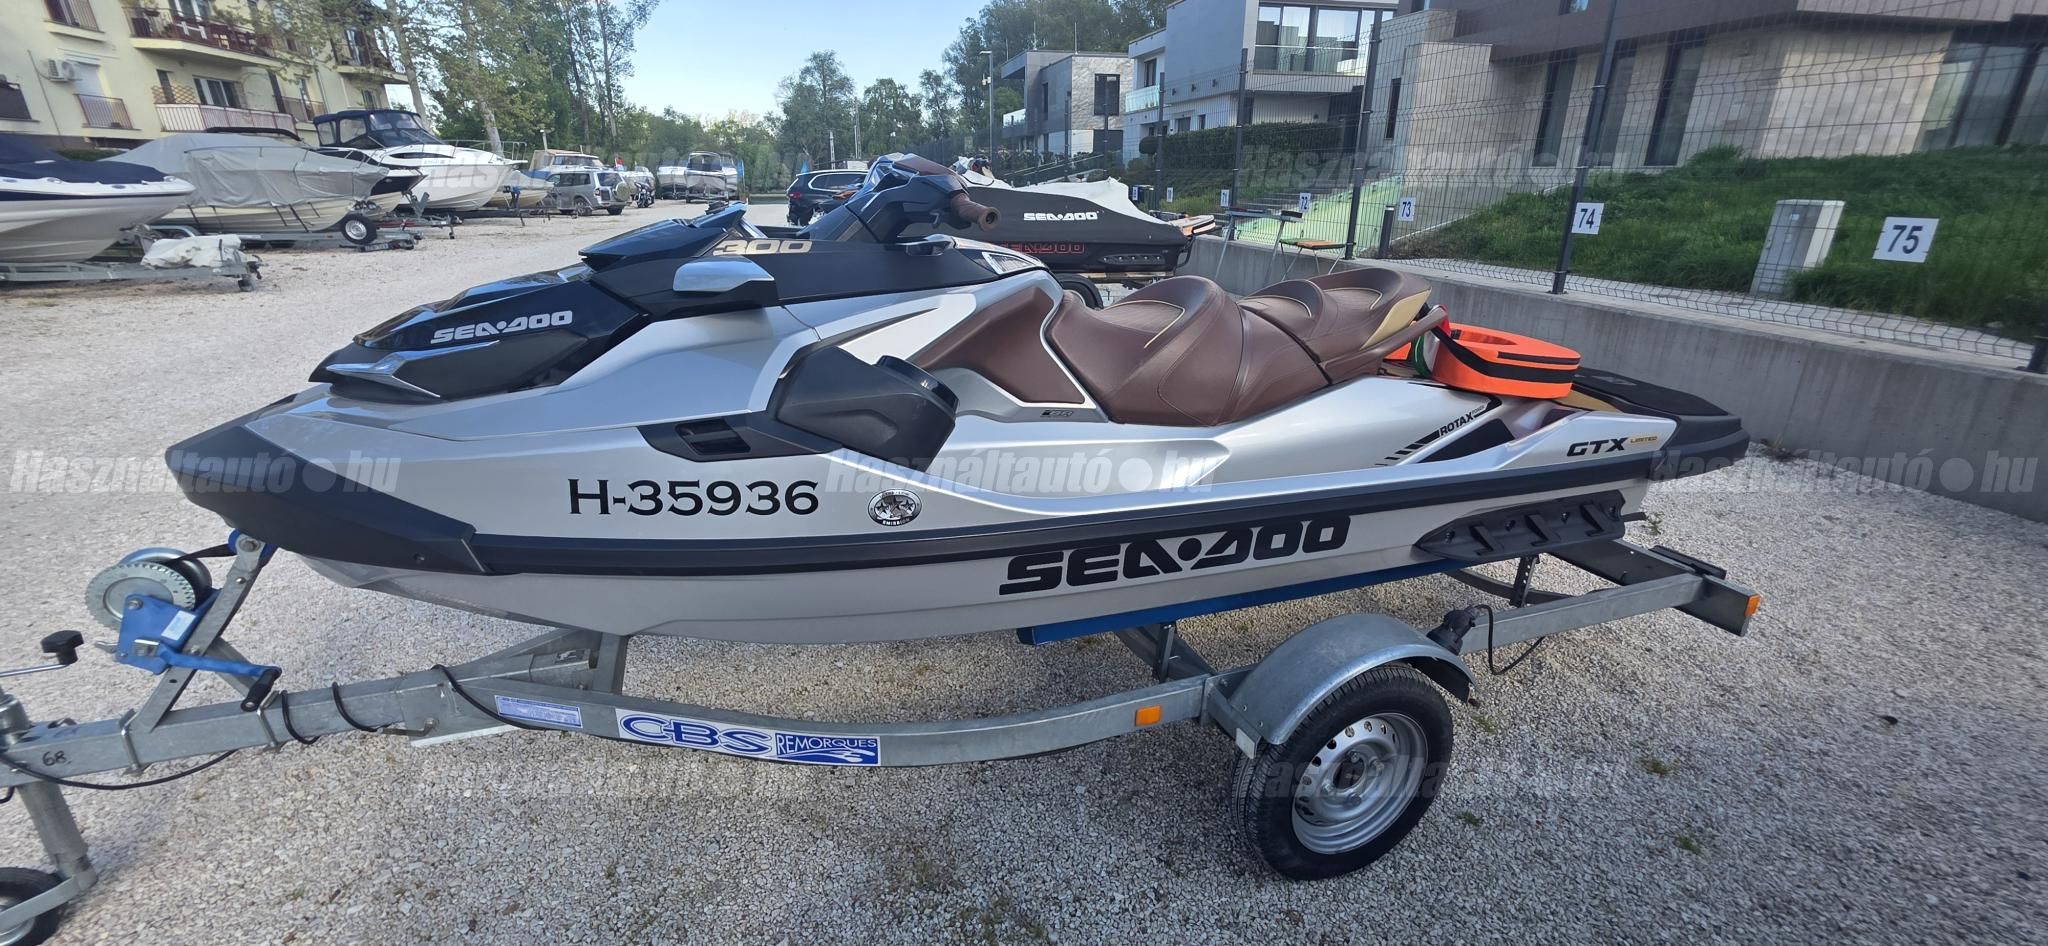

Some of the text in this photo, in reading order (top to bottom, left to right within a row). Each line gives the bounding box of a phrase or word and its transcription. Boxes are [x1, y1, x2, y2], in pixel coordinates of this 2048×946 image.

[1401, 201, 1412, 218] 73
[1578, 207, 1595, 229] 74
[713, 240, 812, 256] 300
[1888, 225, 1923, 254] 75
[1440, 411, 1473, 437] ROTAX
[1566, 437, 1629, 457] GTX
[568, 479, 819, 516] H-35936
[620, 714, 773, 755] CBS
[776, 733, 877, 756] REMORQUES
